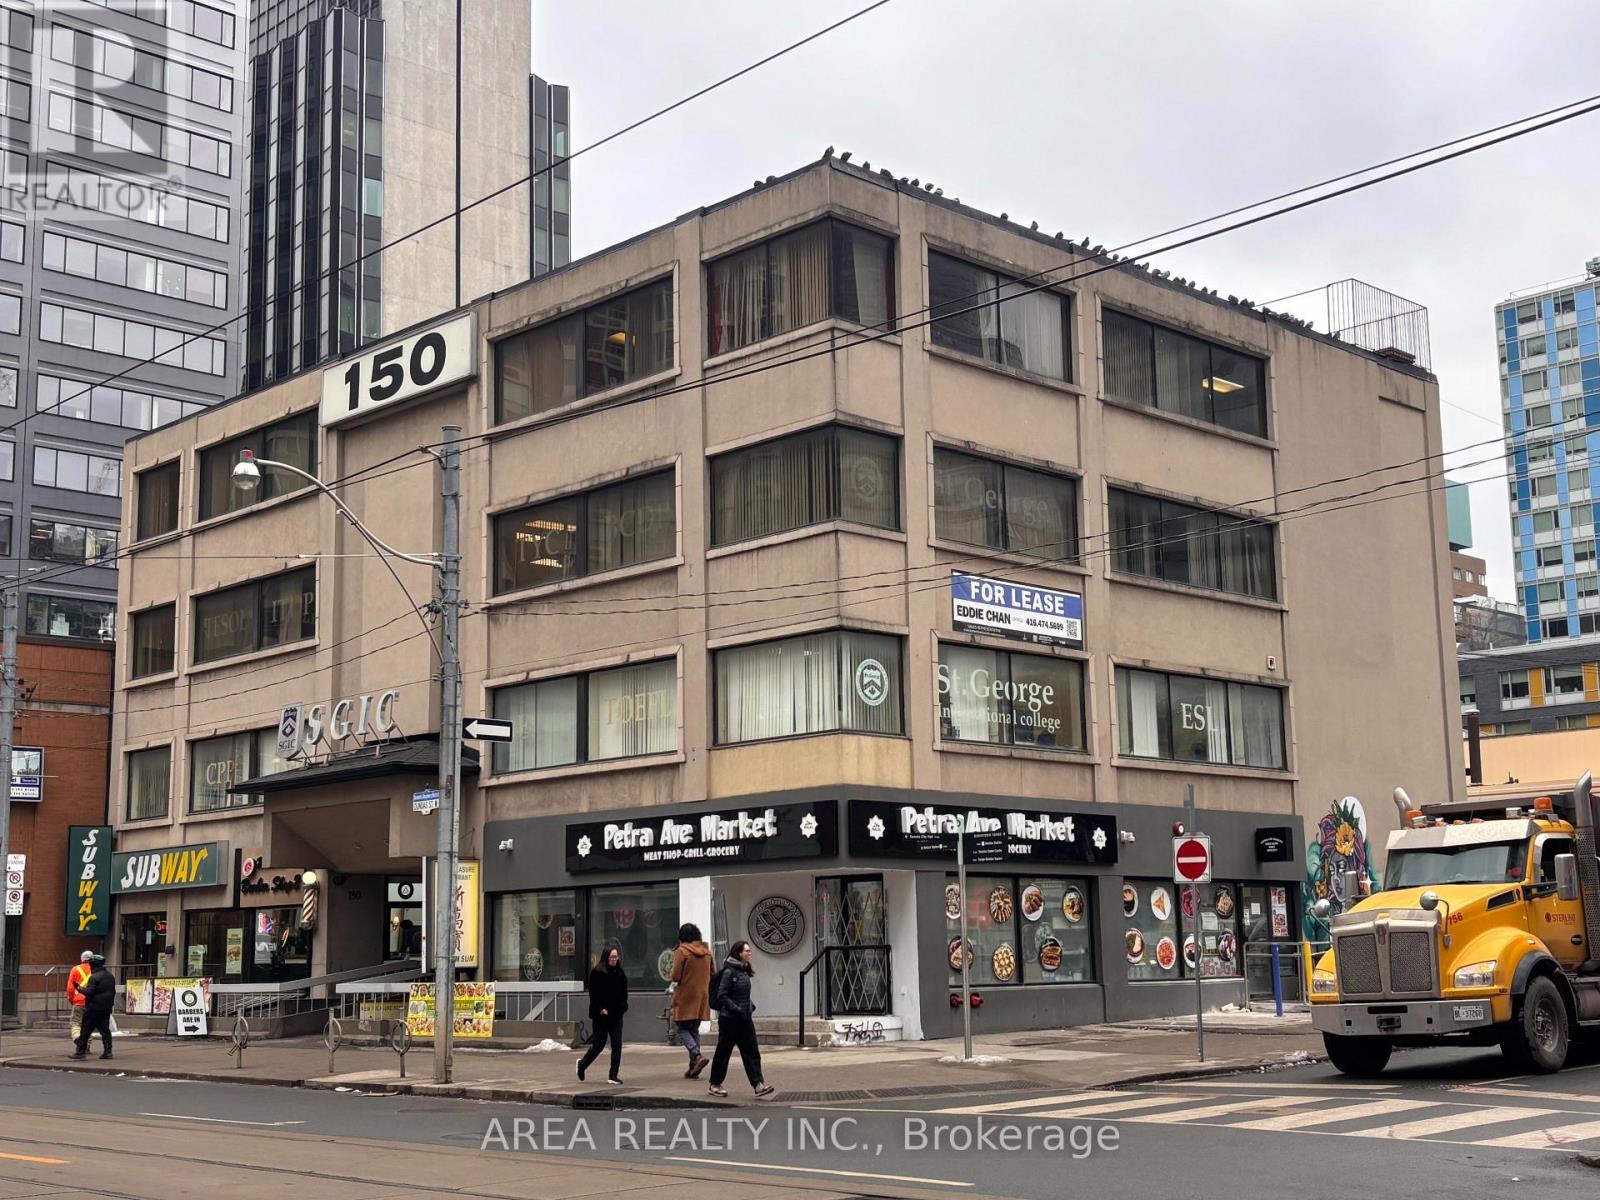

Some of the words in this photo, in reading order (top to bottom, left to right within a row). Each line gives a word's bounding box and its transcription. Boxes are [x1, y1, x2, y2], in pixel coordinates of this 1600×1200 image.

[344, 332, 447, 411] 150
[956, 605, 984, 620] EDDIE
[986, 610, 1011, 625] CHAN
[970, 581, 1006, 605] FOR
[1011, 588, 1065, 615] LEASE
[969, 668, 1055, 712] George
[306, 689, 400, 746] SGIC
[1020, 710, 1061, 734] college
[1180, 702, 1217, 732] ESL
[278, 738, 296, 750] SGIC
[603, 822, 654, 850] Petra
[659, 818, 694, 845] Ave
[700, 808, 777, 842] Market
[901, 806, 962, 835] Petra
[1006, 812, 1075, 843] Market
[120, 848, 208, 891] SUBWAY
[643, 853, 662, 861] MEAT
[78, 829, 99, 931] SUBWAY
